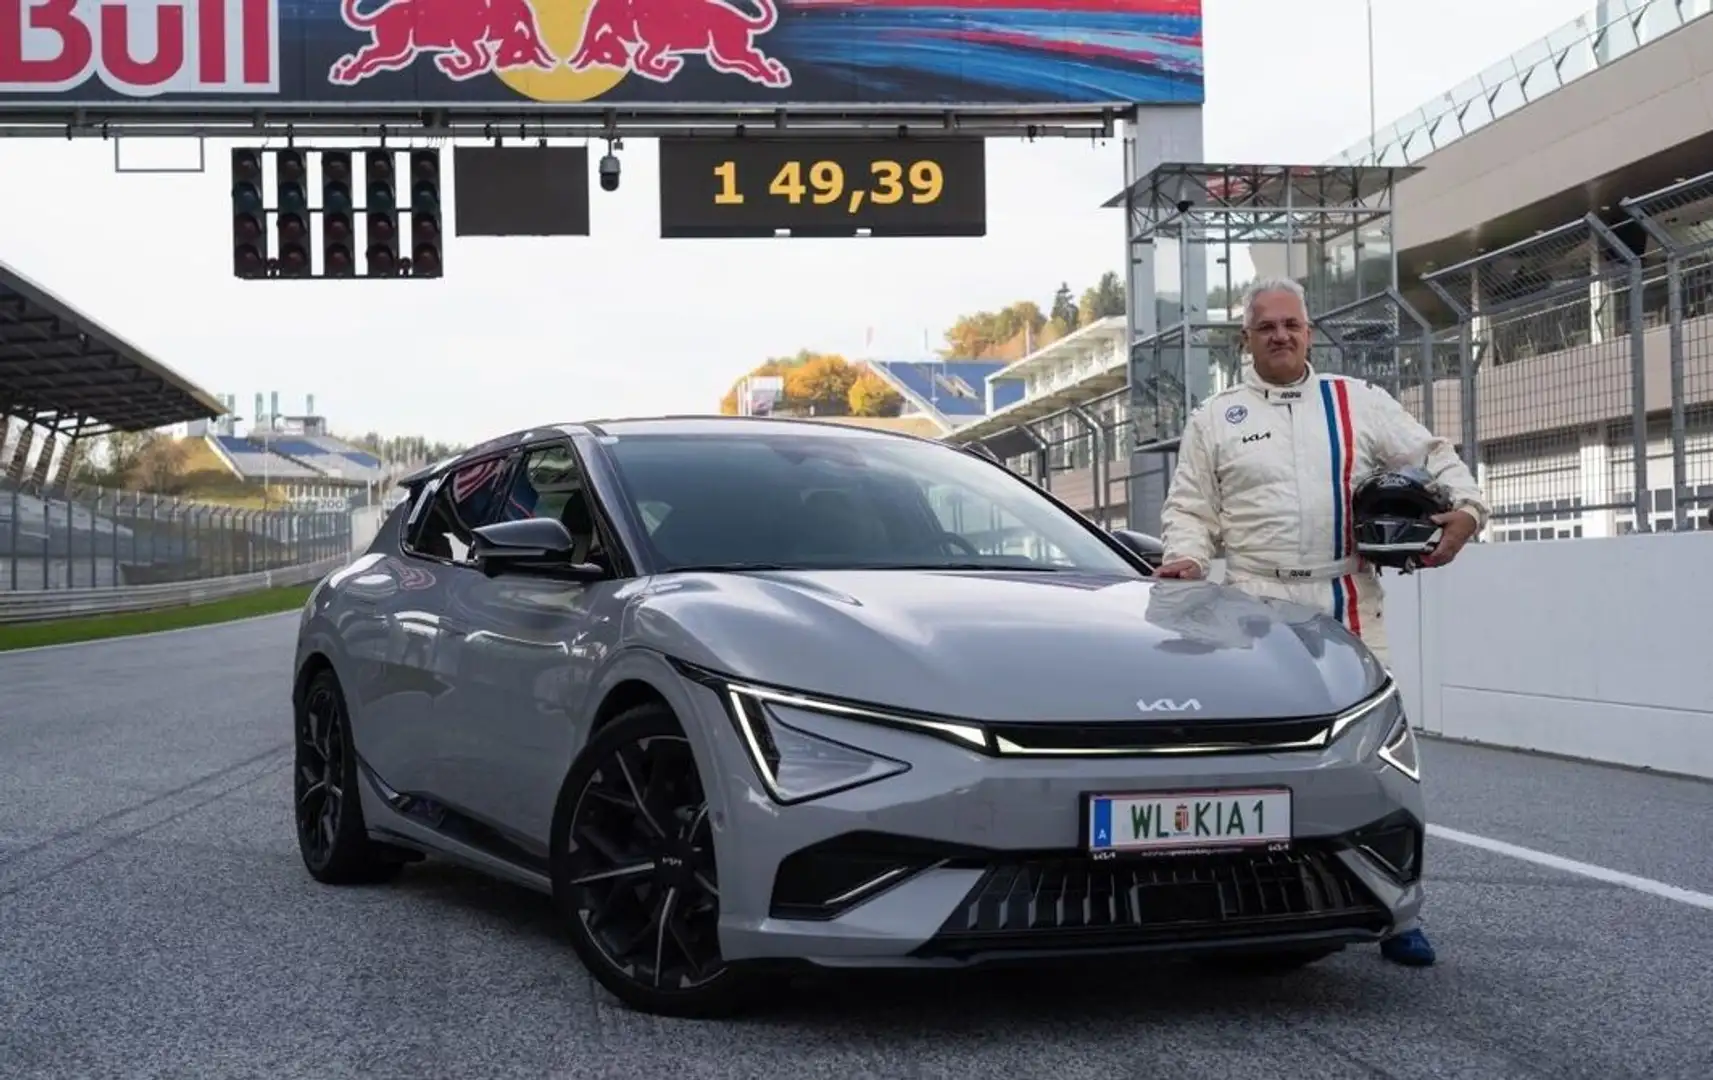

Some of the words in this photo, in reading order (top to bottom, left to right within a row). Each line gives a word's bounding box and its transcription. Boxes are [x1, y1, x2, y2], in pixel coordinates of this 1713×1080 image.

[0, 0, 270, 85] Bull
[713, 161, 744, 204] 1
[769, 160, 944, 213] 49,39
[1242, 431, 1271, 444] KIA
[1136, 699, 1201, 711] KIA
[1131, 803, 1169, 839] WL
[1098, 829, 1107, 840] A
